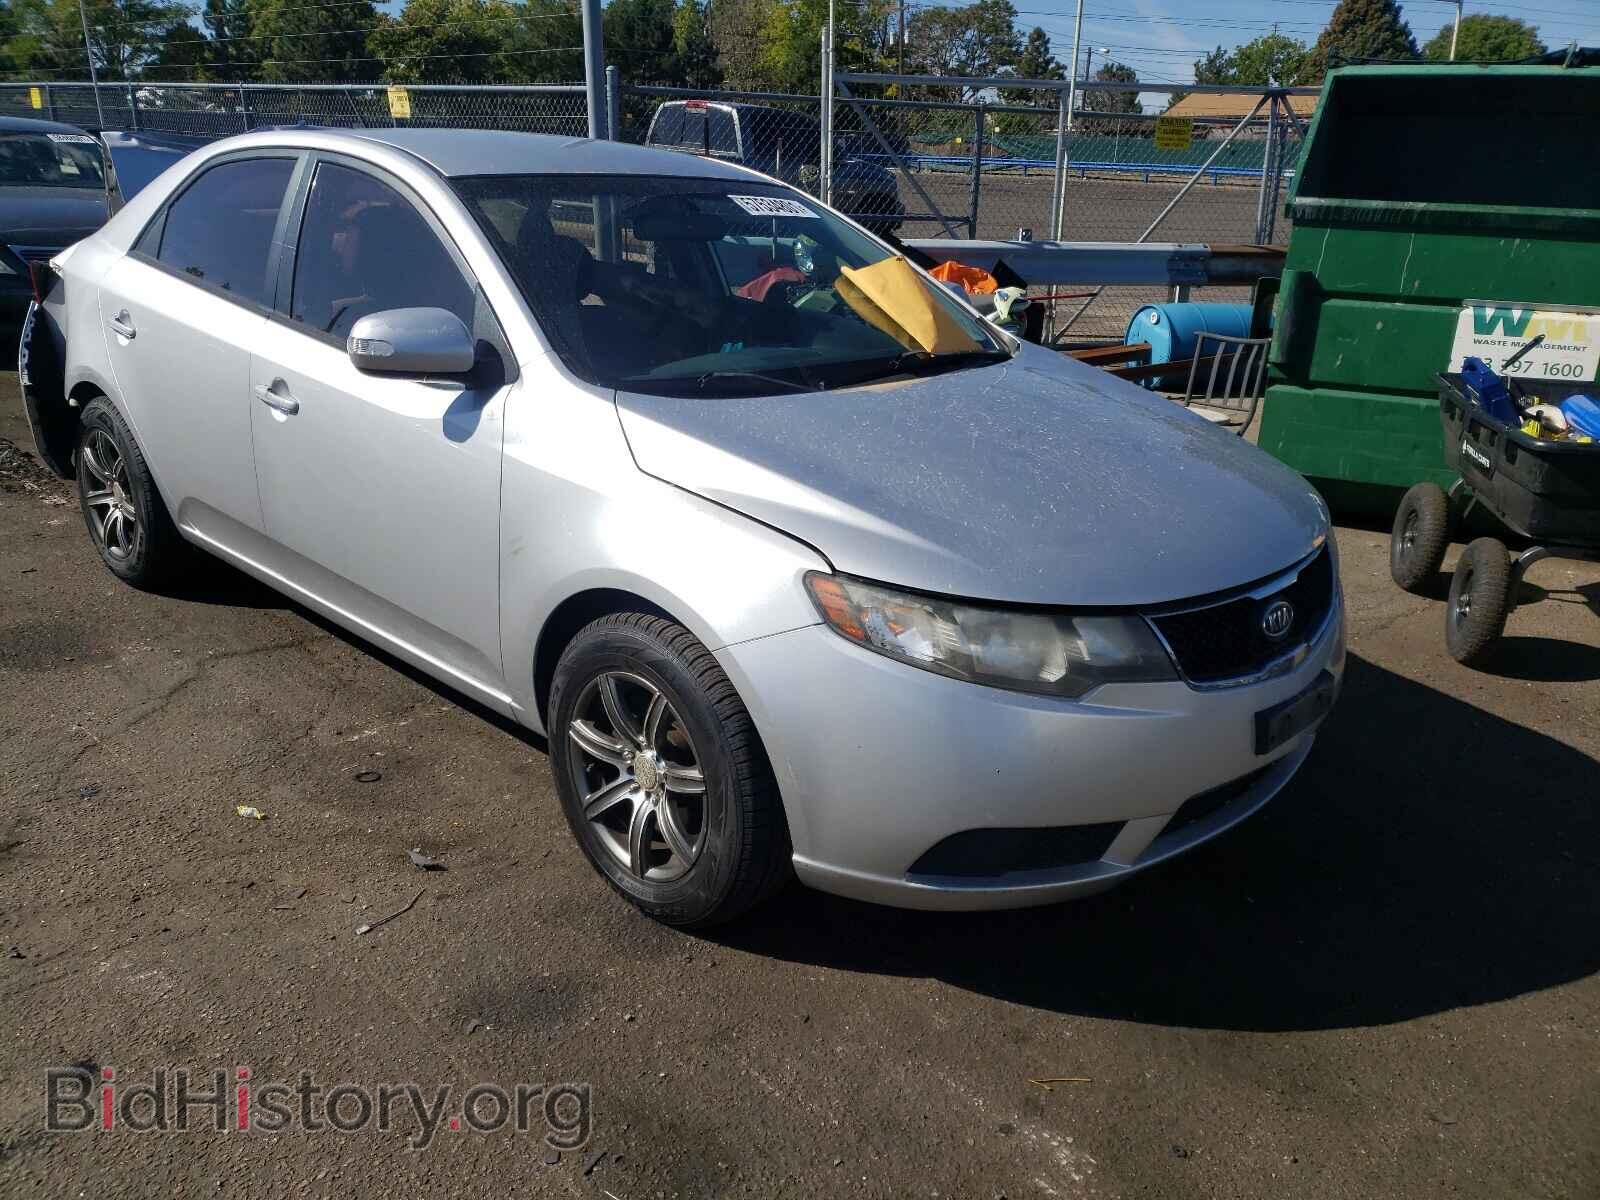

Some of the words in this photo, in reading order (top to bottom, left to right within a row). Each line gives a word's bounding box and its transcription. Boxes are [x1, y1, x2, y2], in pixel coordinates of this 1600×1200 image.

[1473, 338, 1508, 347] WASTE
[1510, 340, 1589, 352] MAAGEMENT
[1542, 362, 1584, 378] 1600
